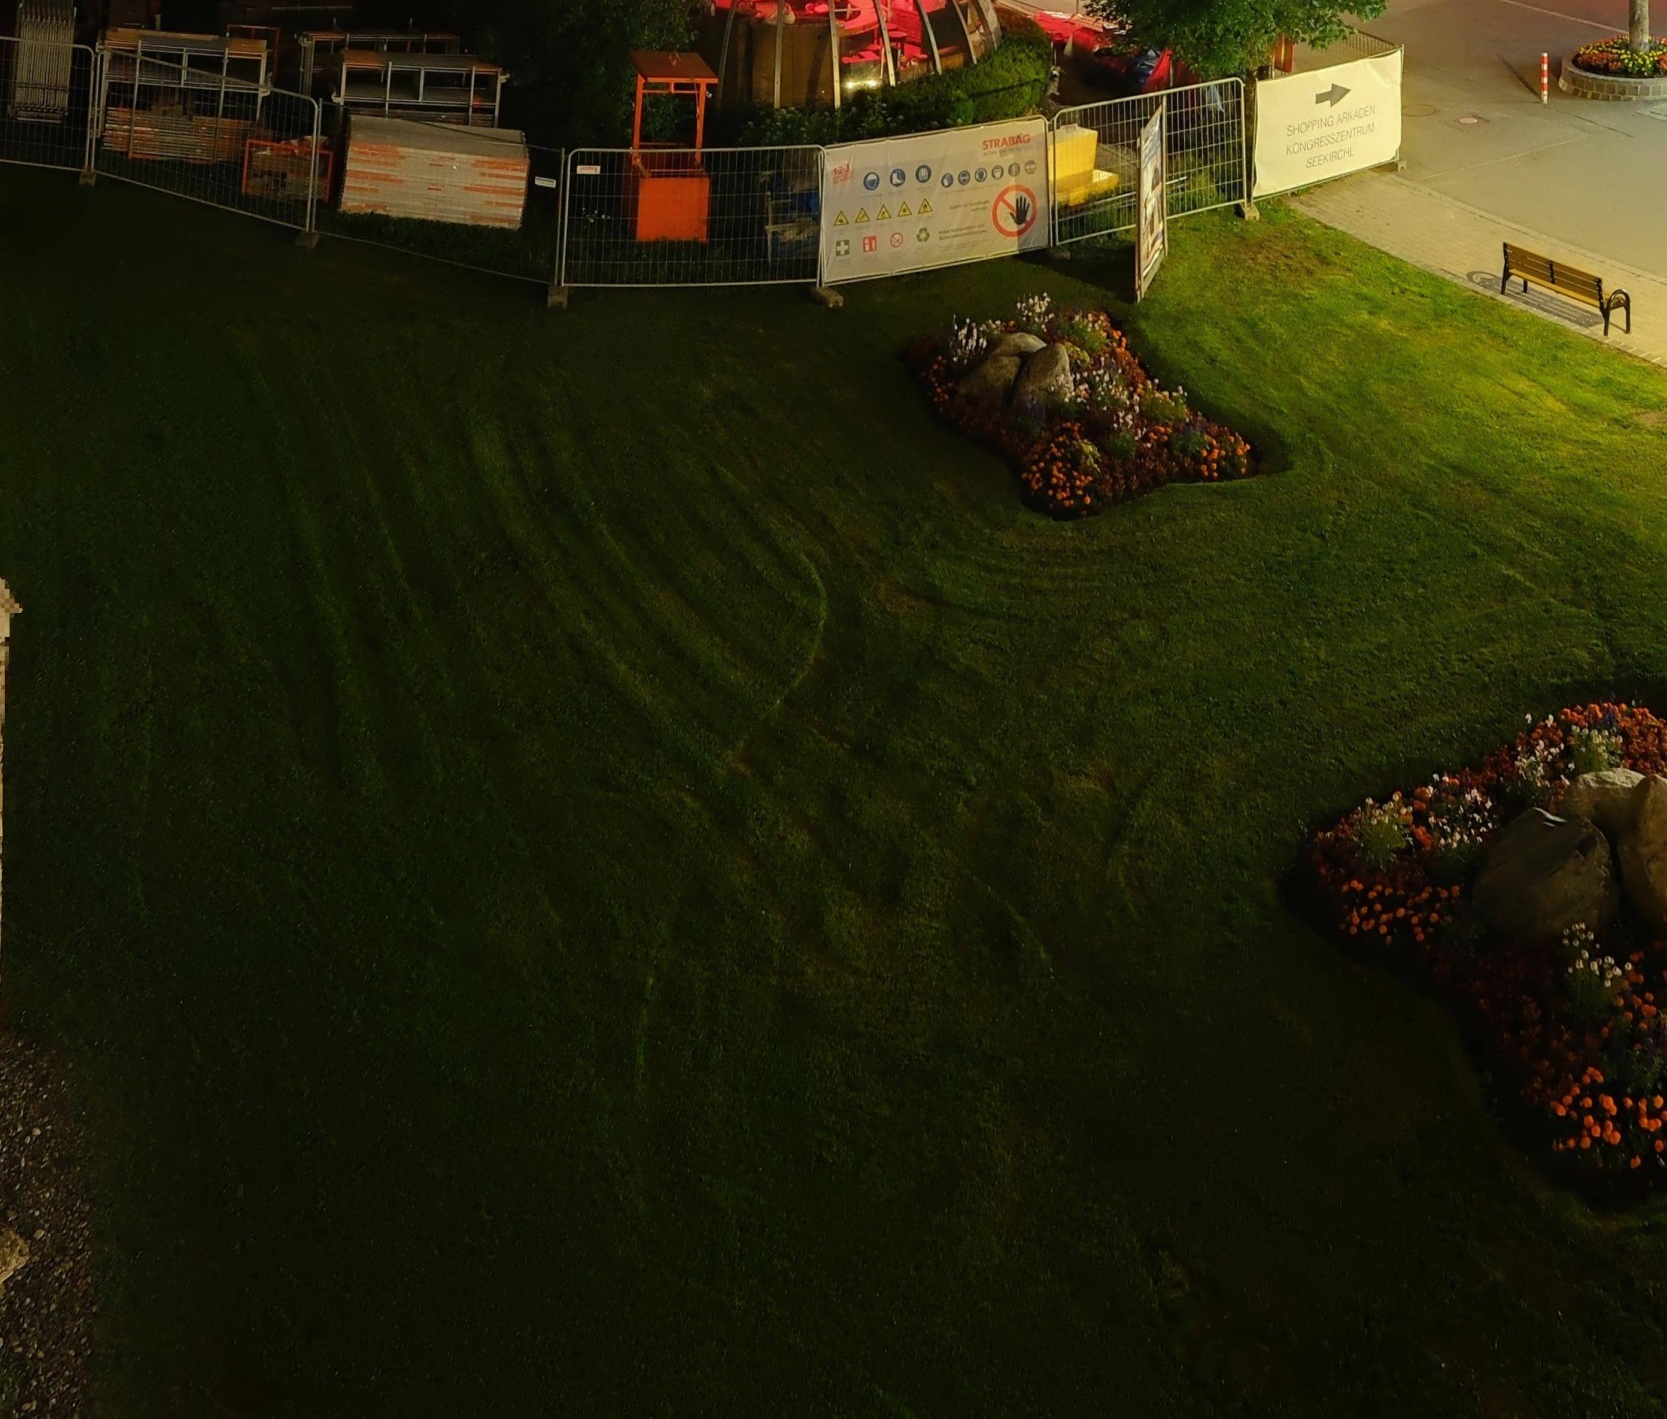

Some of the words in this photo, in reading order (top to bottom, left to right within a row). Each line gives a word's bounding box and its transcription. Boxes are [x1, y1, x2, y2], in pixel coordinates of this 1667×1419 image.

[1285, 115, 1335, 138] SHOPPING
[1336, 104, 1377, 124] ARKADEN
[982, 133, 1031, 151] STRABAG
[1285, 123, 1376, 157] KONGRESSZENTRUM
[1305, 146, 1355, 169] SEEKIRCHL
